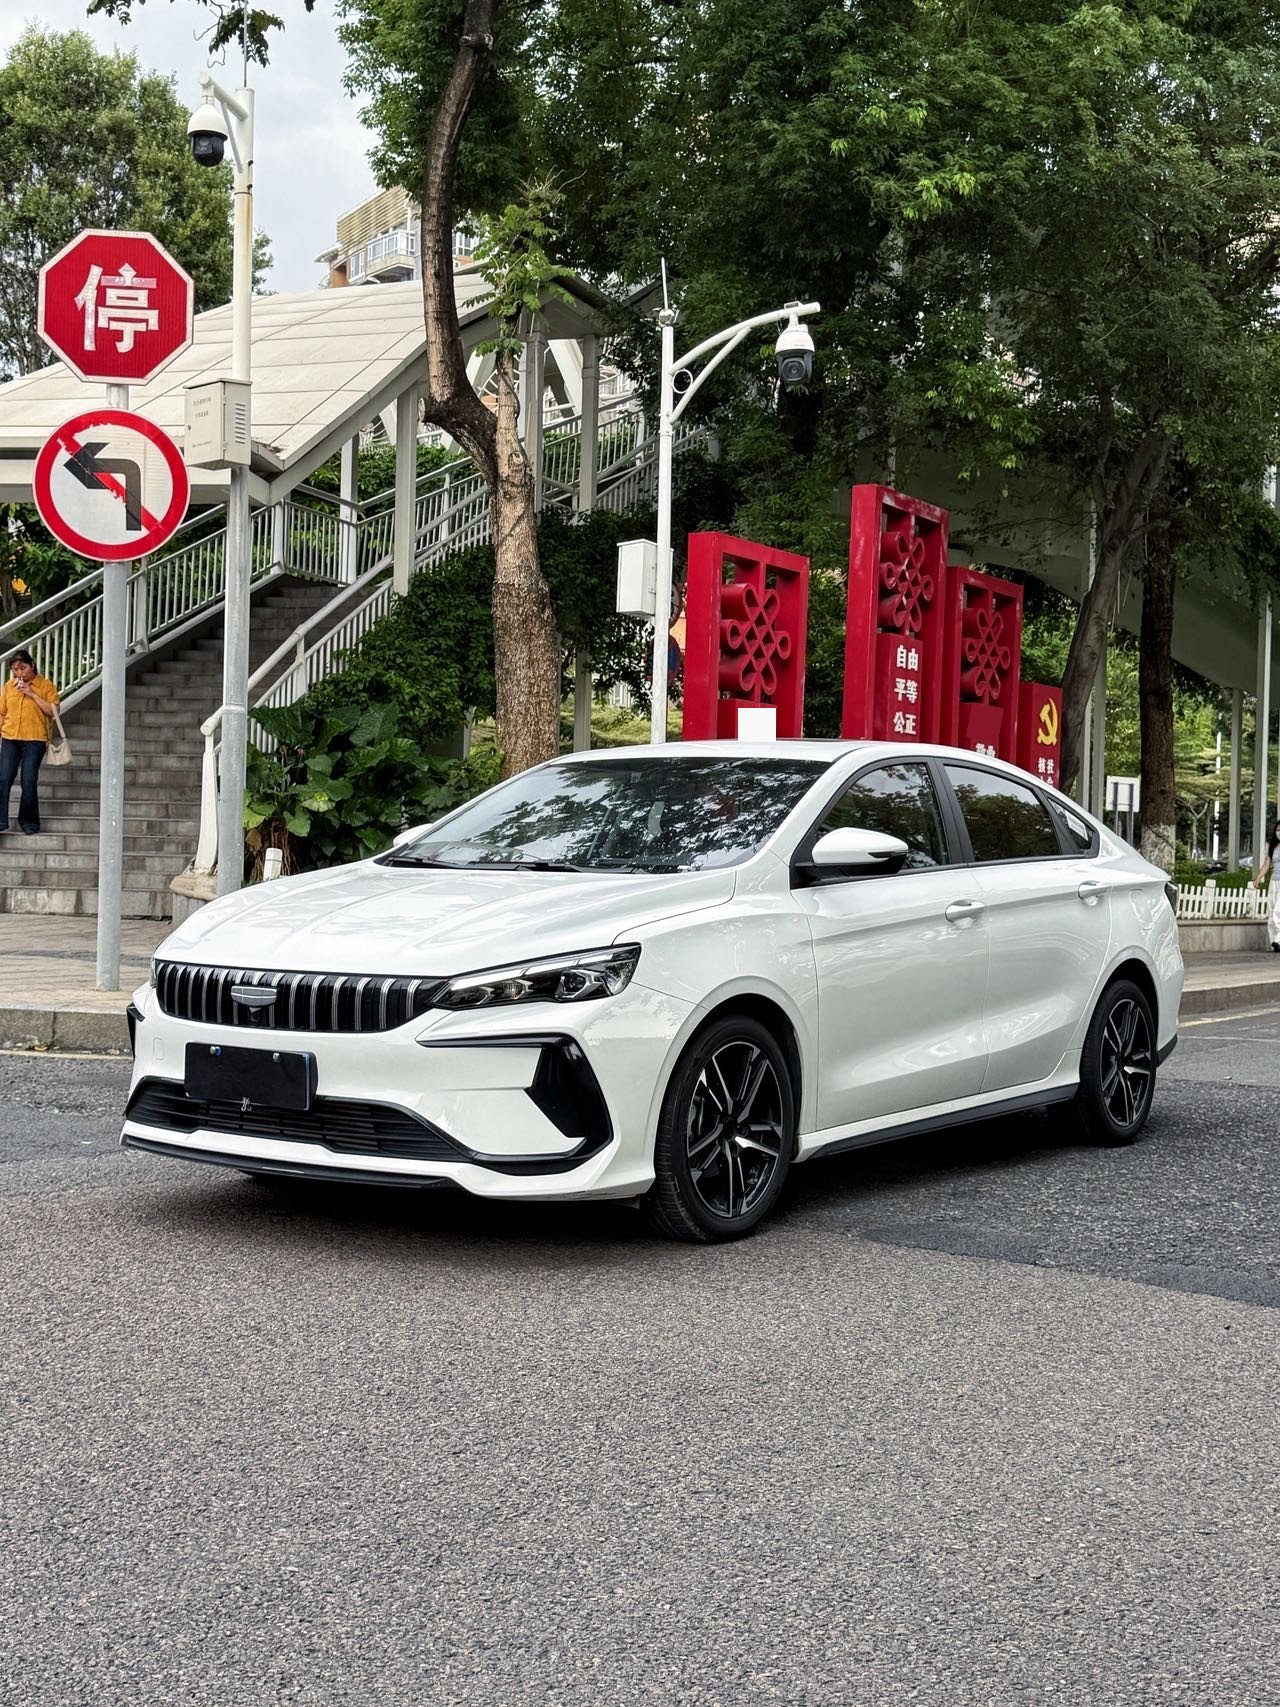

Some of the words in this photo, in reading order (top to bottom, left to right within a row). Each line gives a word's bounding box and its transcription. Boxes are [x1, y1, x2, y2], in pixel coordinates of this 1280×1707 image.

[74, 263, 159, 353] 停
[896, 644, 919, 672] 自由
[894, 678, 918, 704] 平等
[893, 711, 917, 735] 公正
